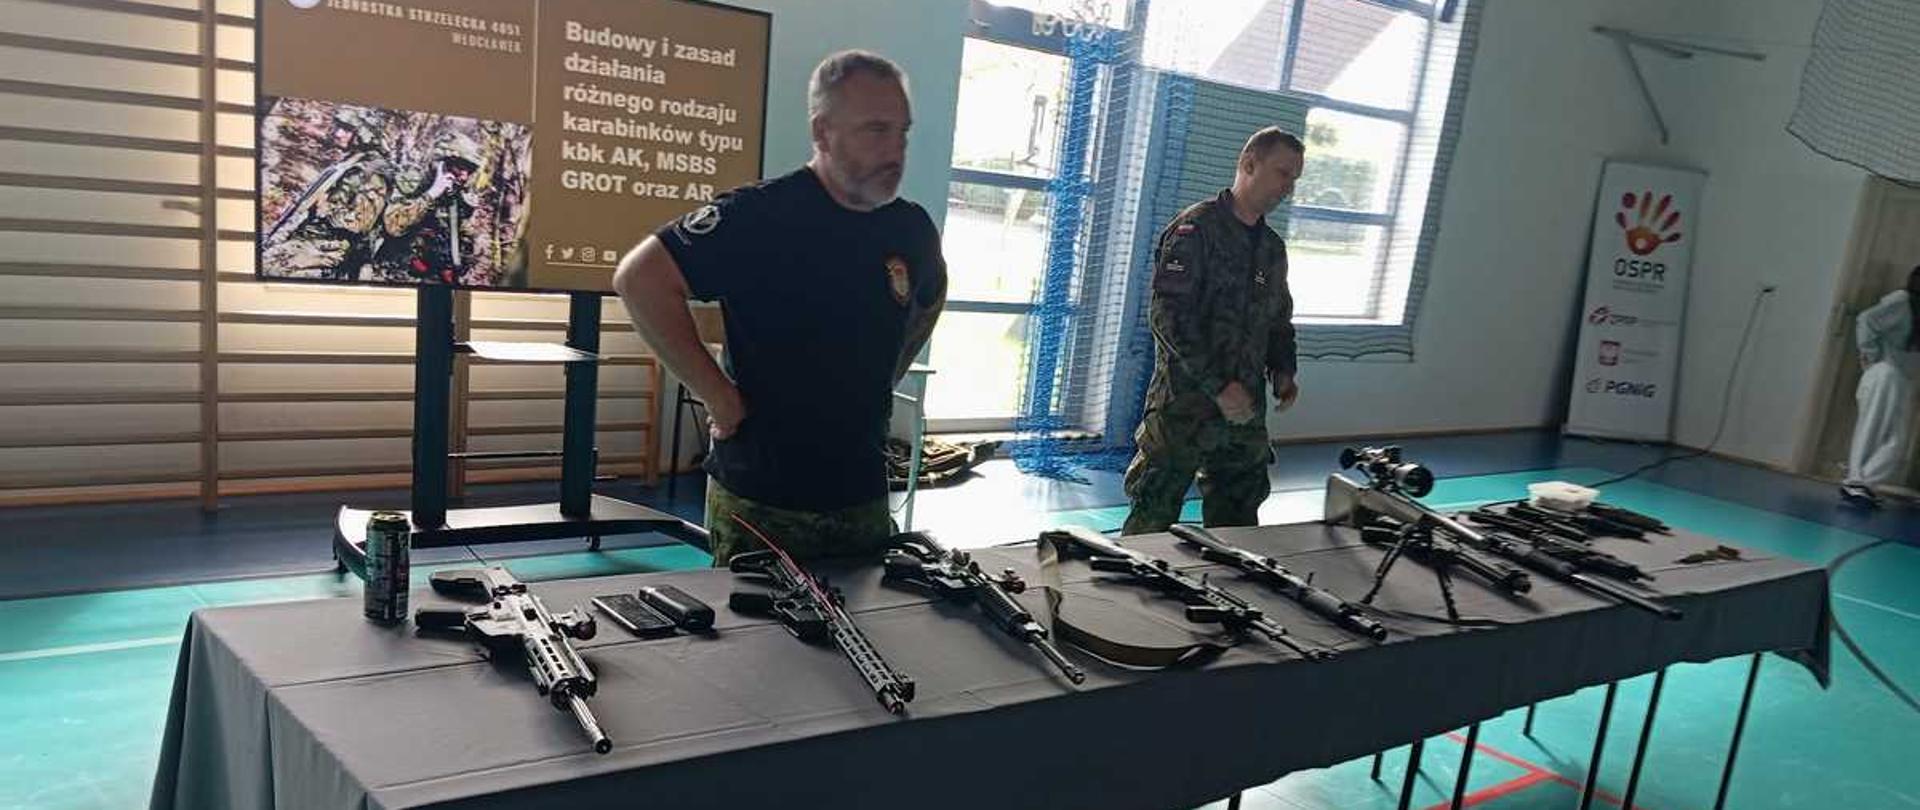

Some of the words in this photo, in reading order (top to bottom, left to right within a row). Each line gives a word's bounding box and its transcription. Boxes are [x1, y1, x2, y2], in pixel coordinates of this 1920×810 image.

[408, 8, 487, 30] STRZELECKA
[492, 21, 520, 36] 4051
[565, 20, 656, 58] Budowy
[661, 37, 669, 57] i
[674, 43, 737, 68] zasad
[564, 52, 666, 85] działania
[563, 83, 655, 115] różnego
[660, 98, 737, 126] rodzaju
[562, 111, 693, 145] karabinków
[699, 129, 744, 153] typu
[561, 140, 605, 164] kbk
[610, 146, 650, 173] AK,
[656, 151, 717, 175] MSBS
[561, 169, 628, 193] GROT
[632, 180, 680, 199] oraz
[684, 182, 714, 202] AR
[1613, 258, 1664, 281] OSPR
